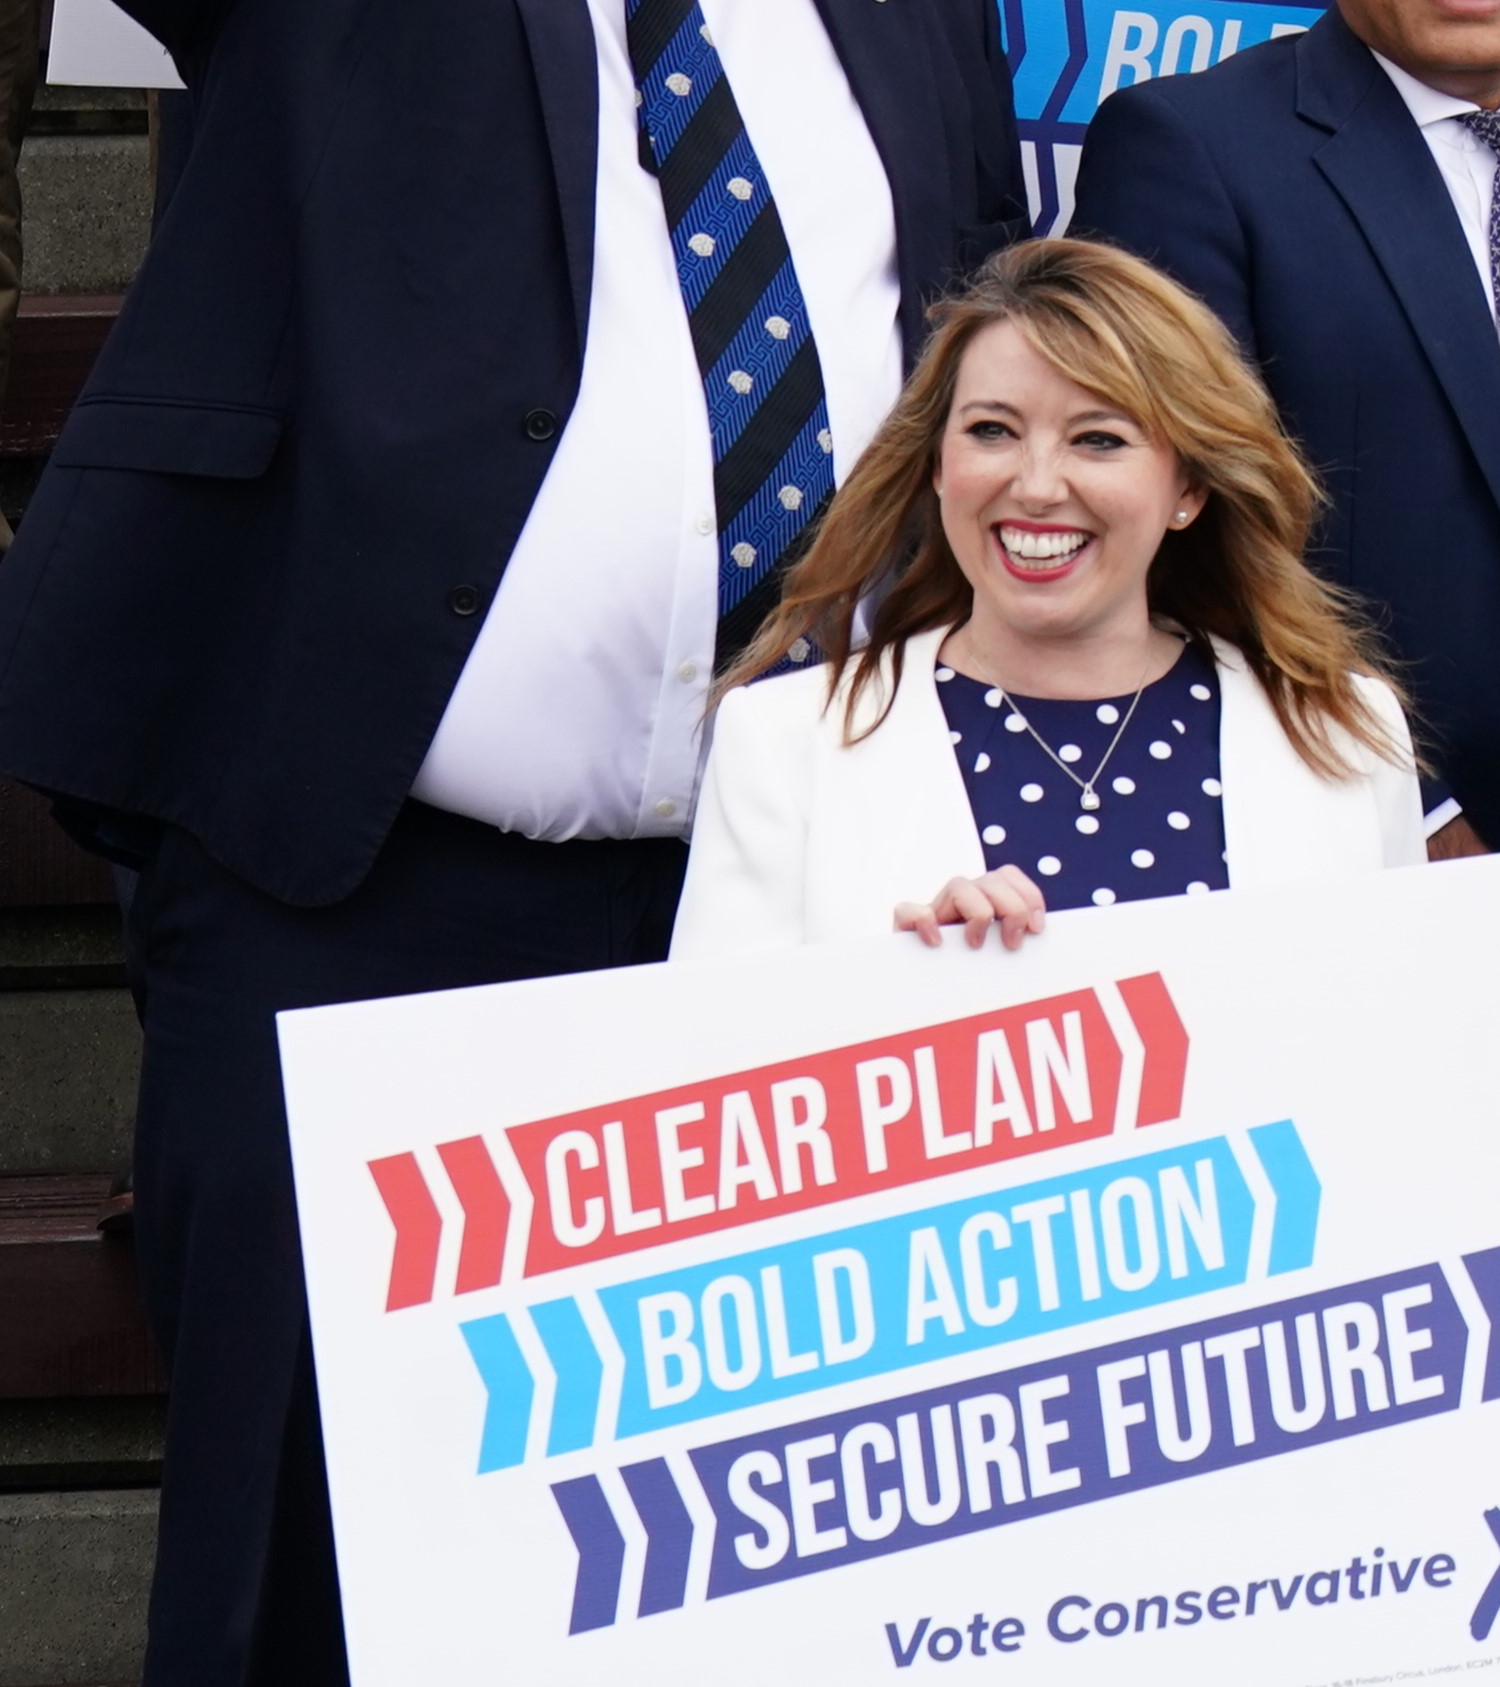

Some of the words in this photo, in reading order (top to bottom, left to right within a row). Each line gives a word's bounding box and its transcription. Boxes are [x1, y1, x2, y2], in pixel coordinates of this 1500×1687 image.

[546, 1075, 839, 1250] CLEAR
[861, 1012, 1093, 1178] PLAN
[645, 1250, 875, 1412] BOLD
[904, 1160, 1225, 1346] ACTION
[726, 1388, 1082, 1572] SECURE
[1103, 1284, 1446, 1481] FUTURE
[882, 1603, 1027, 1669] Vote
[1043, 1545, 1457, 1644] Conservative
